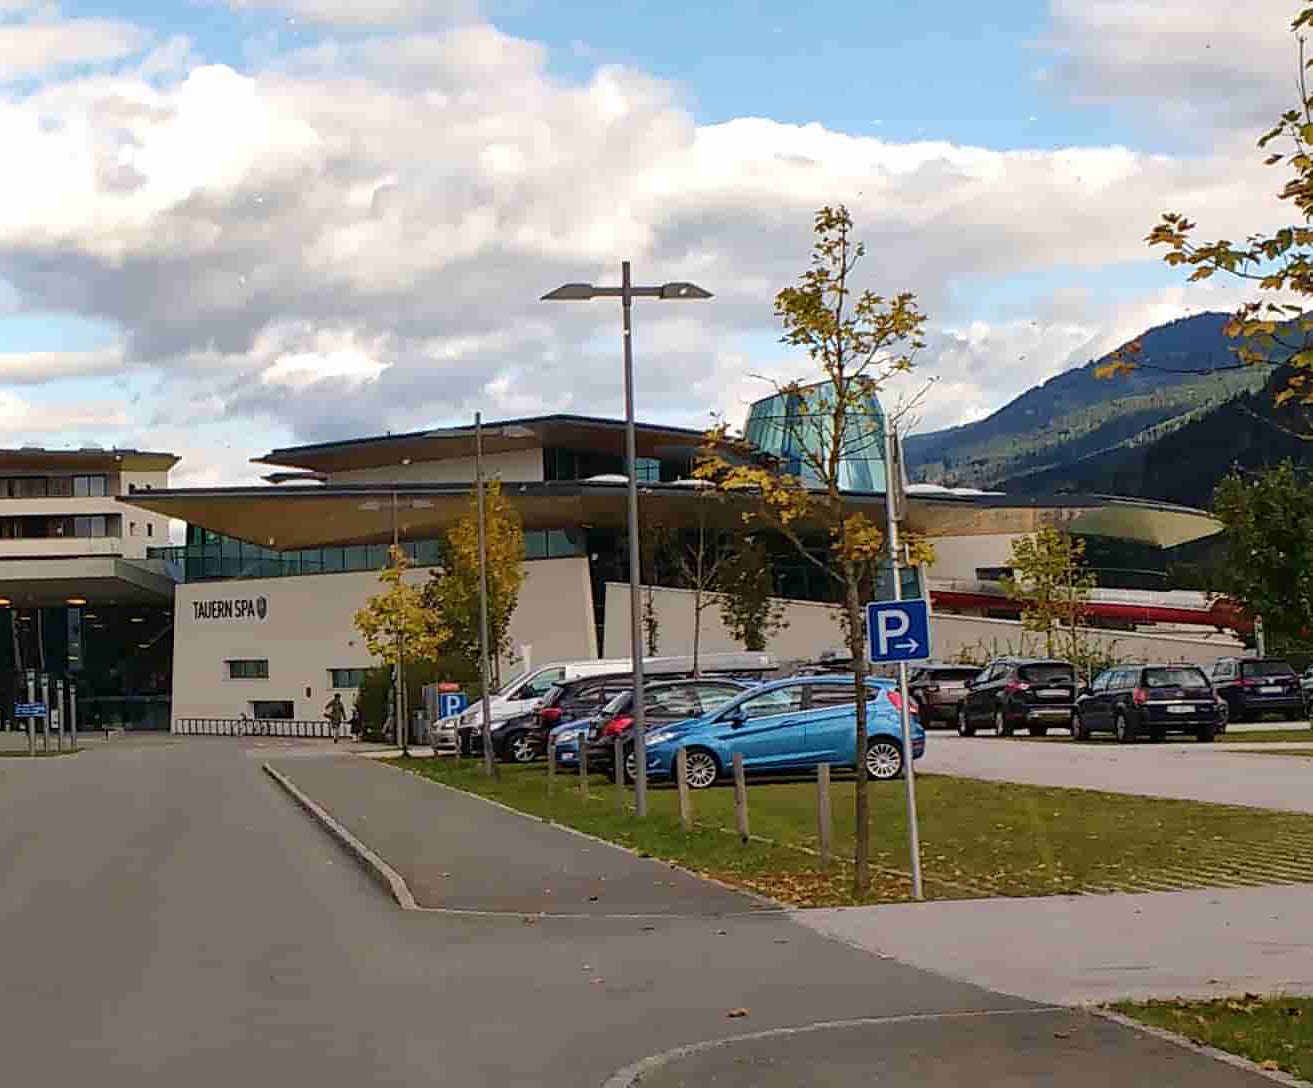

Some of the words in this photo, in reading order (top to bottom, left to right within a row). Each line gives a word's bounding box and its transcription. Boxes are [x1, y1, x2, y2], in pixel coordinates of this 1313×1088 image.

[193, 600, 233, 619] TAUERN
[234, 599, 255, 617] SPA
[878, 609, 910, 655] P
[446, 695, 461, 716] P
